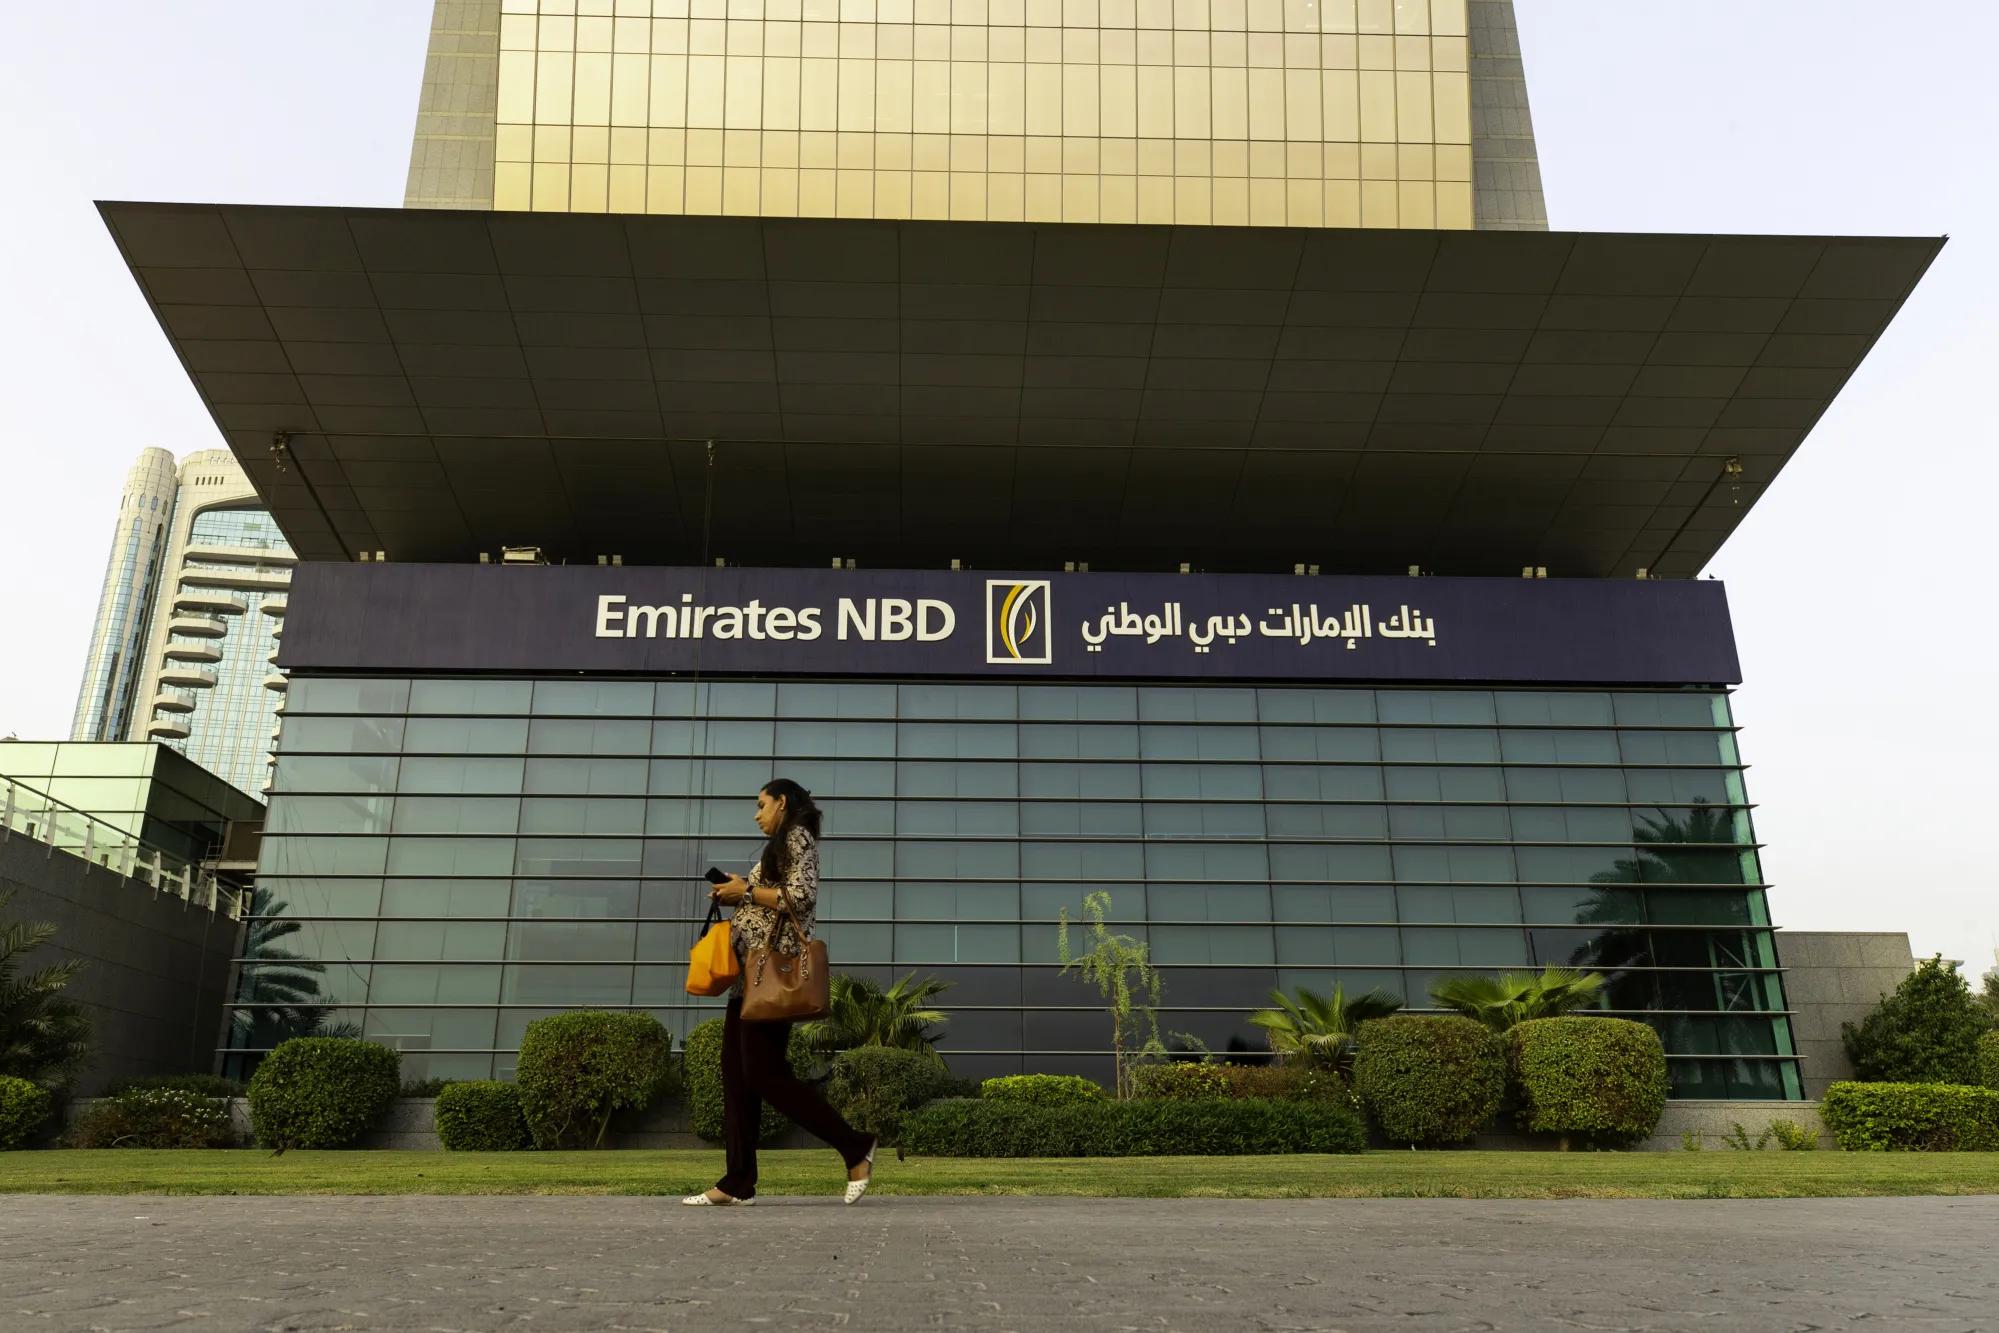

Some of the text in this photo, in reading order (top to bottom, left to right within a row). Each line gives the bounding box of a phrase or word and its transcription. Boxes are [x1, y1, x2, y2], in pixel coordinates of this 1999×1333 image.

[595, 593, 956, 642] Emirates NBD
[1081, 601, 1437, 653] بنك الإمارات دبي الوطني
